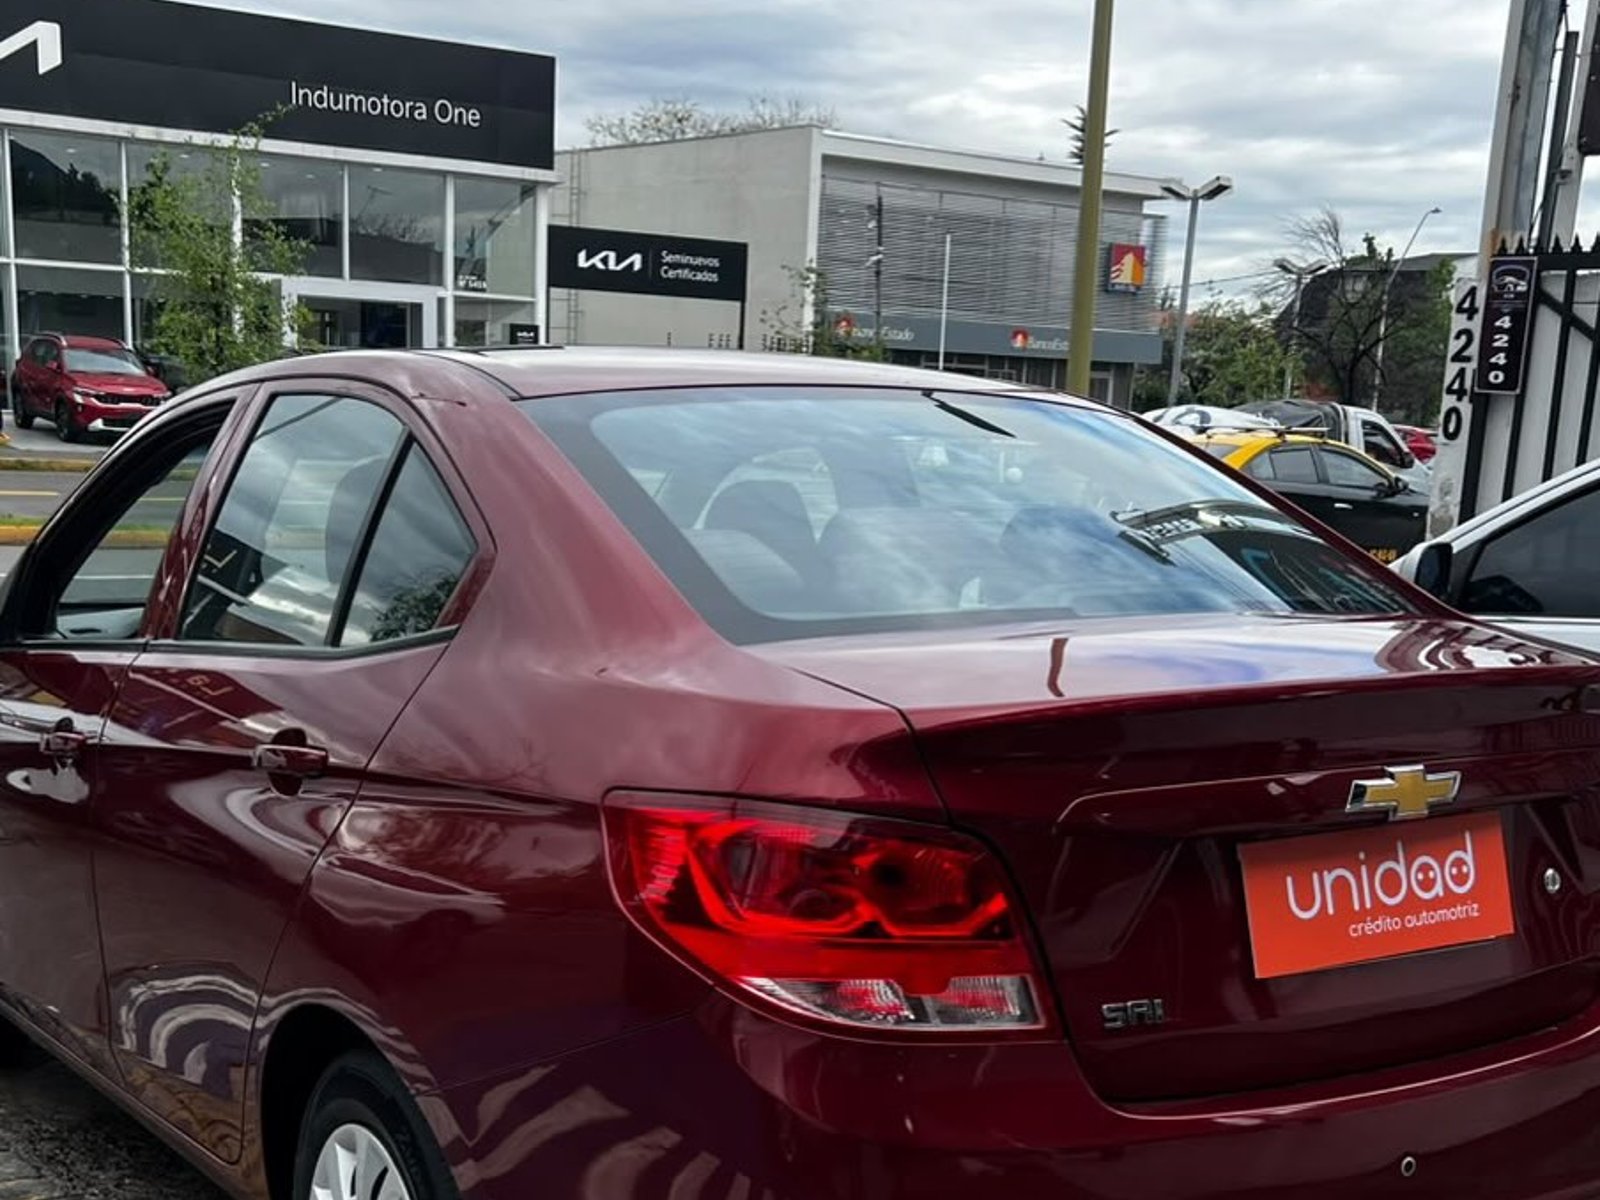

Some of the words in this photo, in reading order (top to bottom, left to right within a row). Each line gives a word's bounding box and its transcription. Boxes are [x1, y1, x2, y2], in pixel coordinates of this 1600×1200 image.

[291, 81, 427, 120] Indumotora
[434, 99, 481, 127] One
[661, 250, 720, 267] Seminuevos
[661, 266, 719, 282] Certificados
[1442, 285, 1480, 441] 4240
[1488, 315, 1513, 384] 4240
[1286, 830, 1475, 920] unidad
[1349, 917, 1401, 937] crédito
[1404, 902, 1481, 928] automotriz
